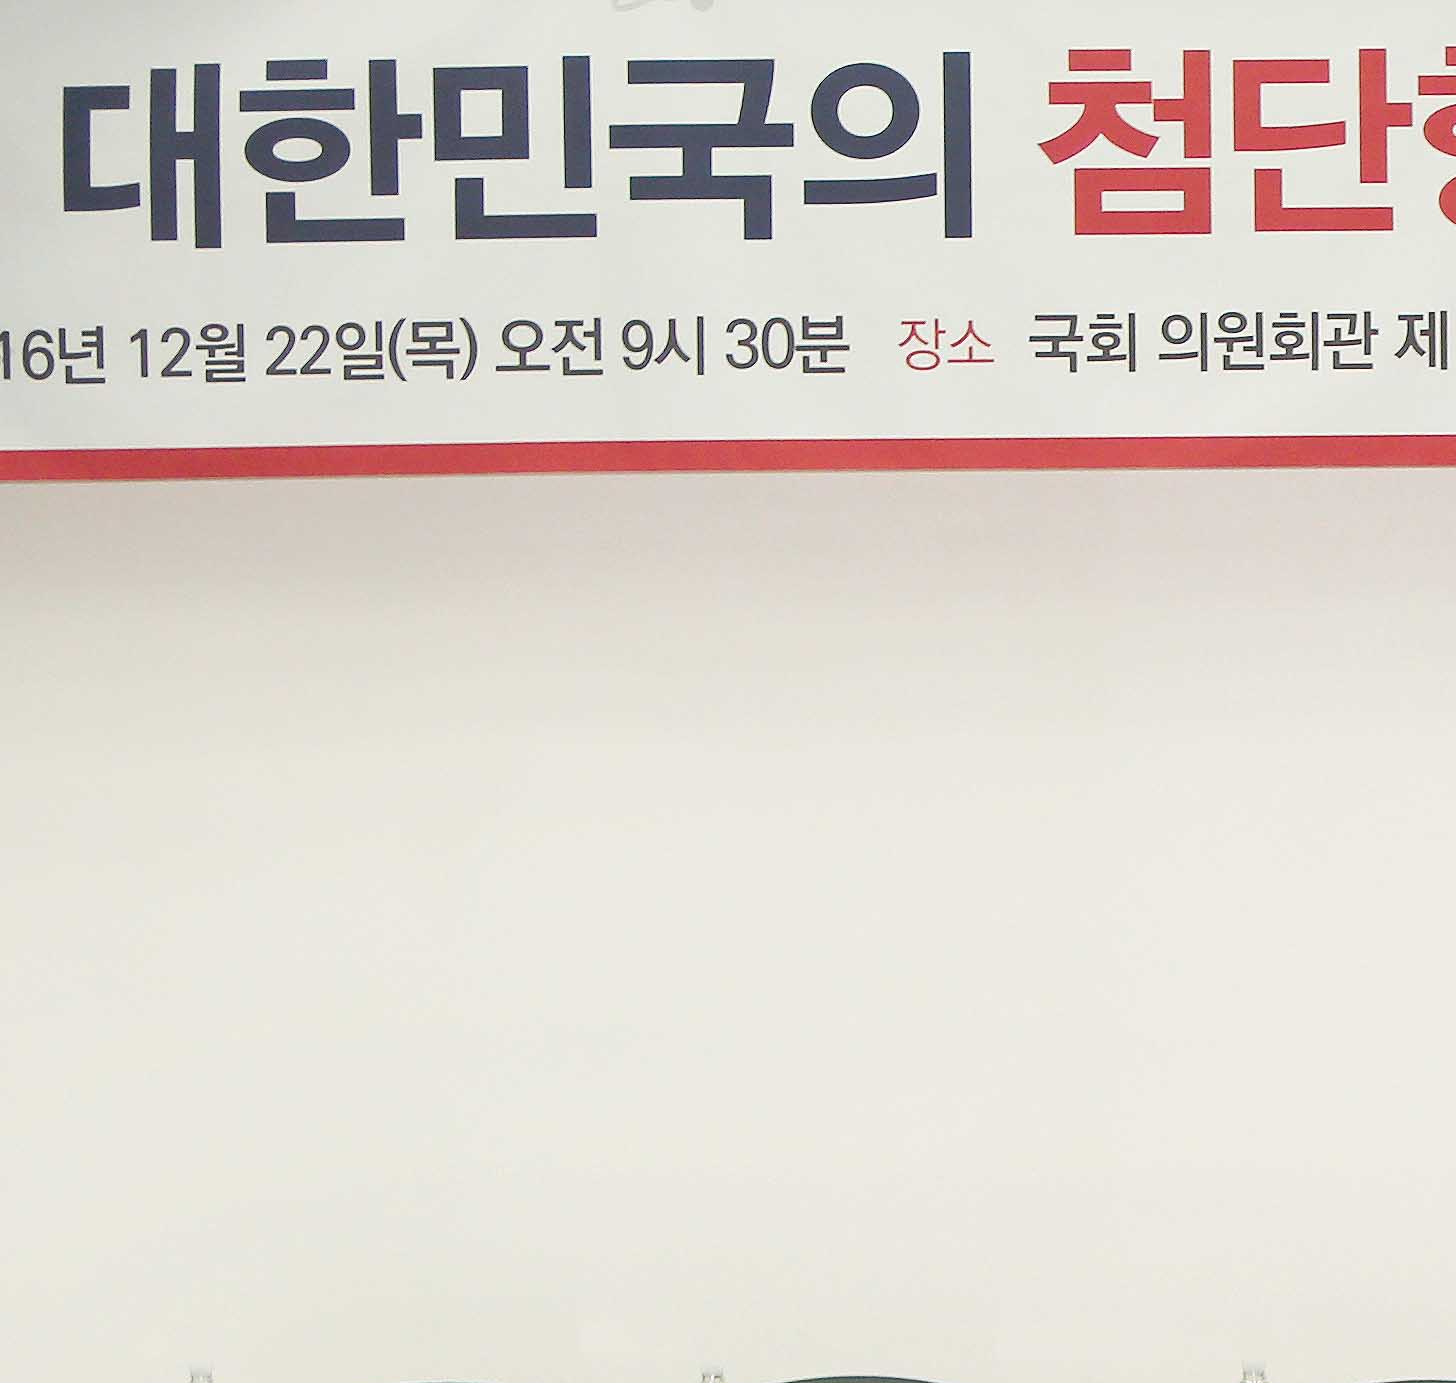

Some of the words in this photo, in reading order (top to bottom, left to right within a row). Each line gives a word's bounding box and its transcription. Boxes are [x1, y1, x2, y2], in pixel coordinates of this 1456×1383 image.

[62, 51, 973, 249] 대한민국의
[130, 323, 247, 383] 12월
[265, 317, 478, 382] 22일(목)
[495, 317, 604, 376] 오전
[621, 315, 705, 376] 9시
[725, 315, 850, 374] 30분
[900, 319, 993, 371] 장소
[1028, 312, 1137, 373] 국회
[1158, 310, 1379, 372] 의원회관
